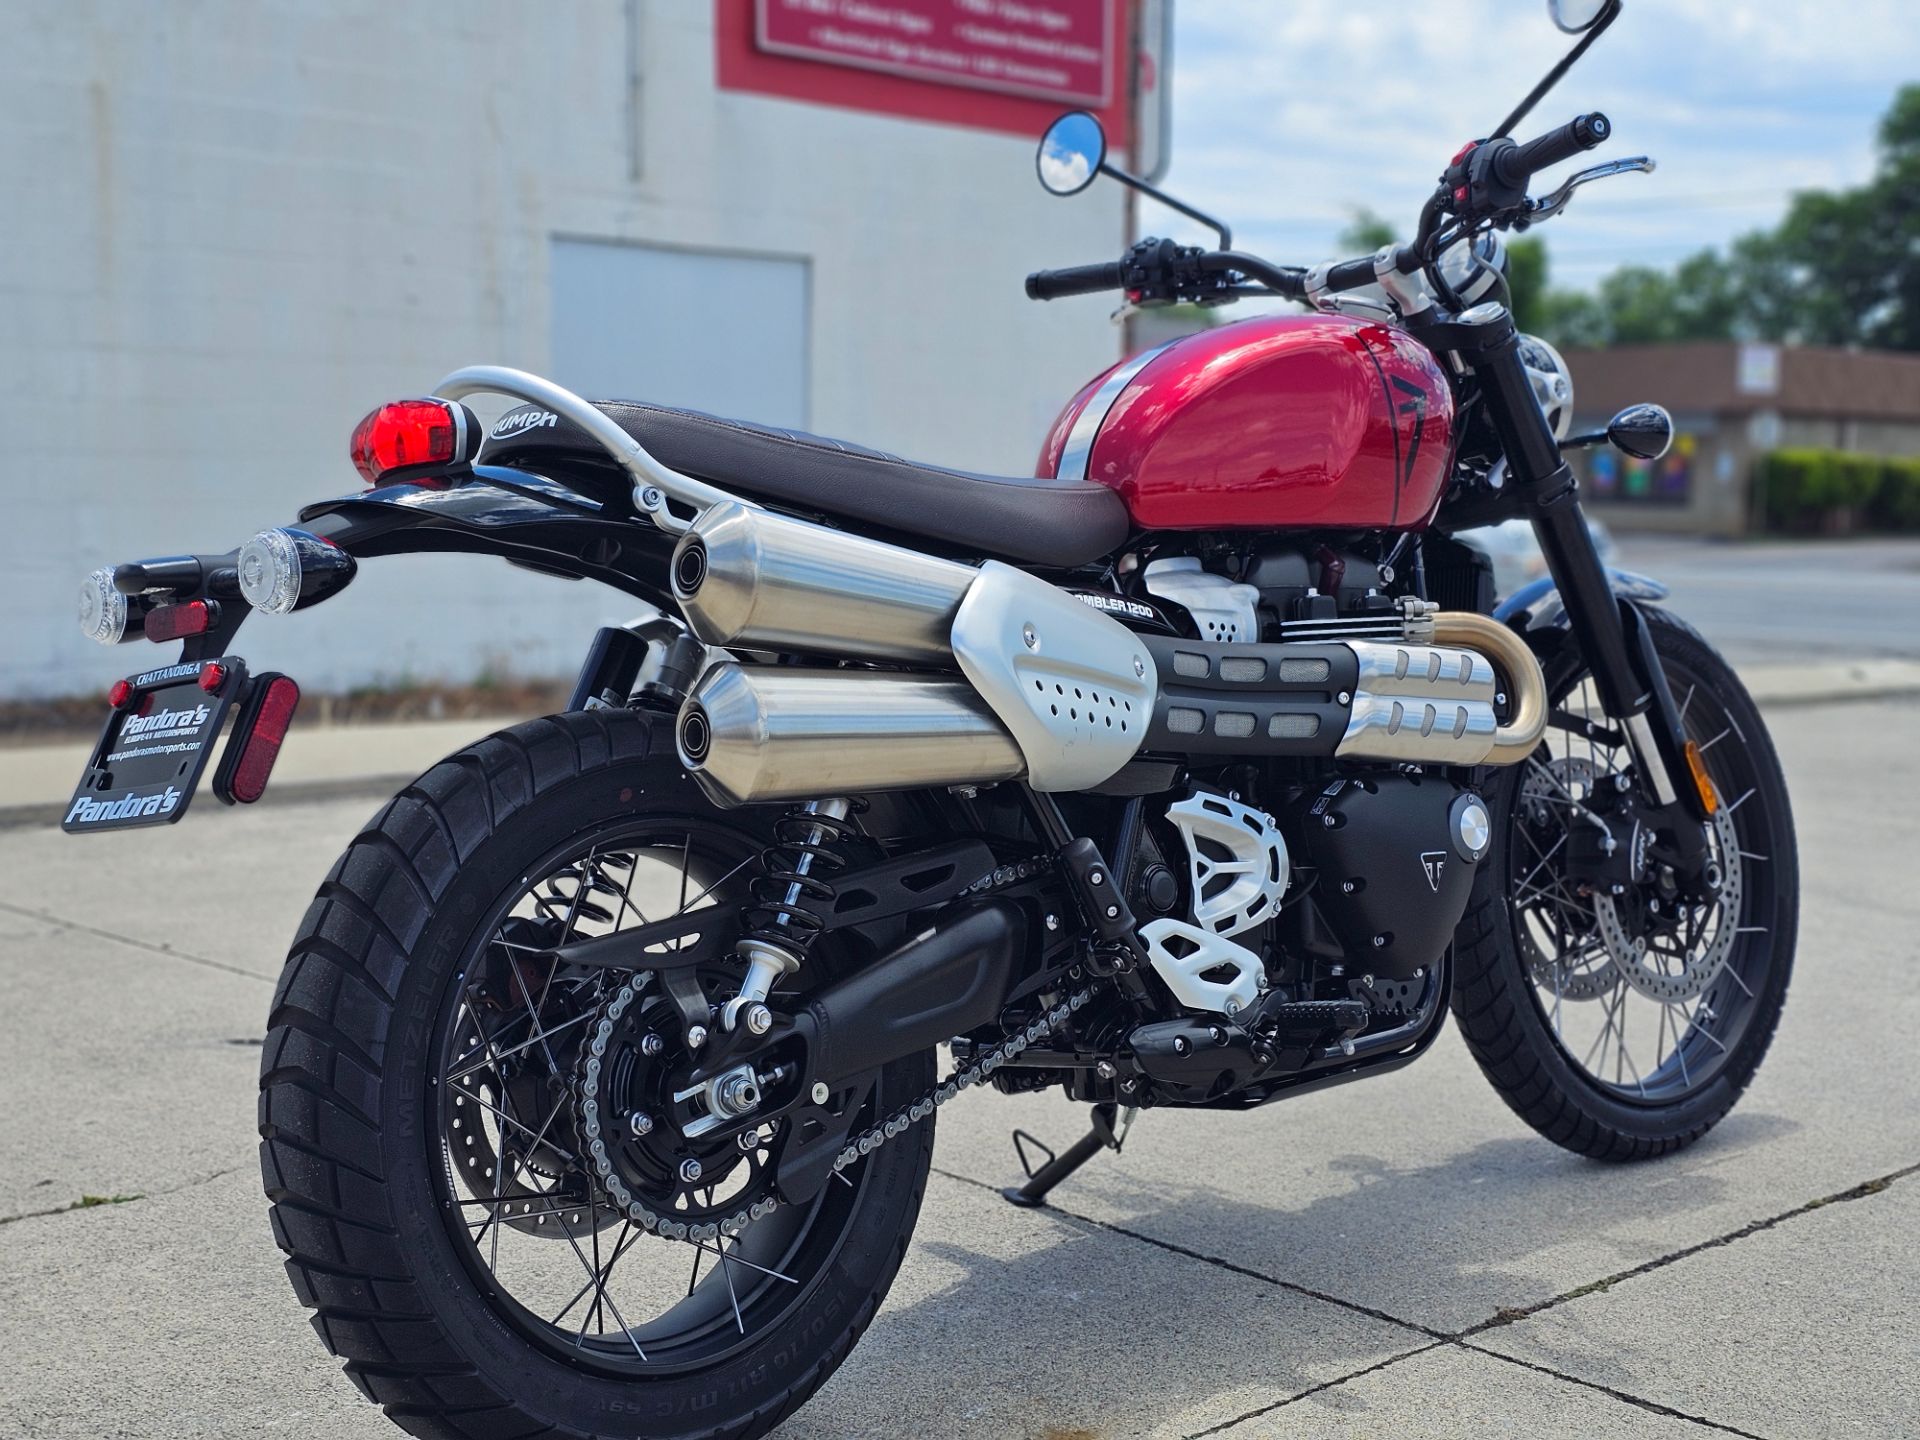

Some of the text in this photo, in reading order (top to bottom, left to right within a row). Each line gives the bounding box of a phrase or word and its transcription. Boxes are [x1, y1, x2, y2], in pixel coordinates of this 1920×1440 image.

[1127, 601, 1154, 618] 1200
[136, 662, 201, 686] CHATTANOOGA
[120, 704, 211, 737] Pandora's
[106, 742, 201, 762] www.pandorasmotorsports.com
[65, 786, 181, 824] Pandora's
[401, 928, 457, 1138] METZELER
